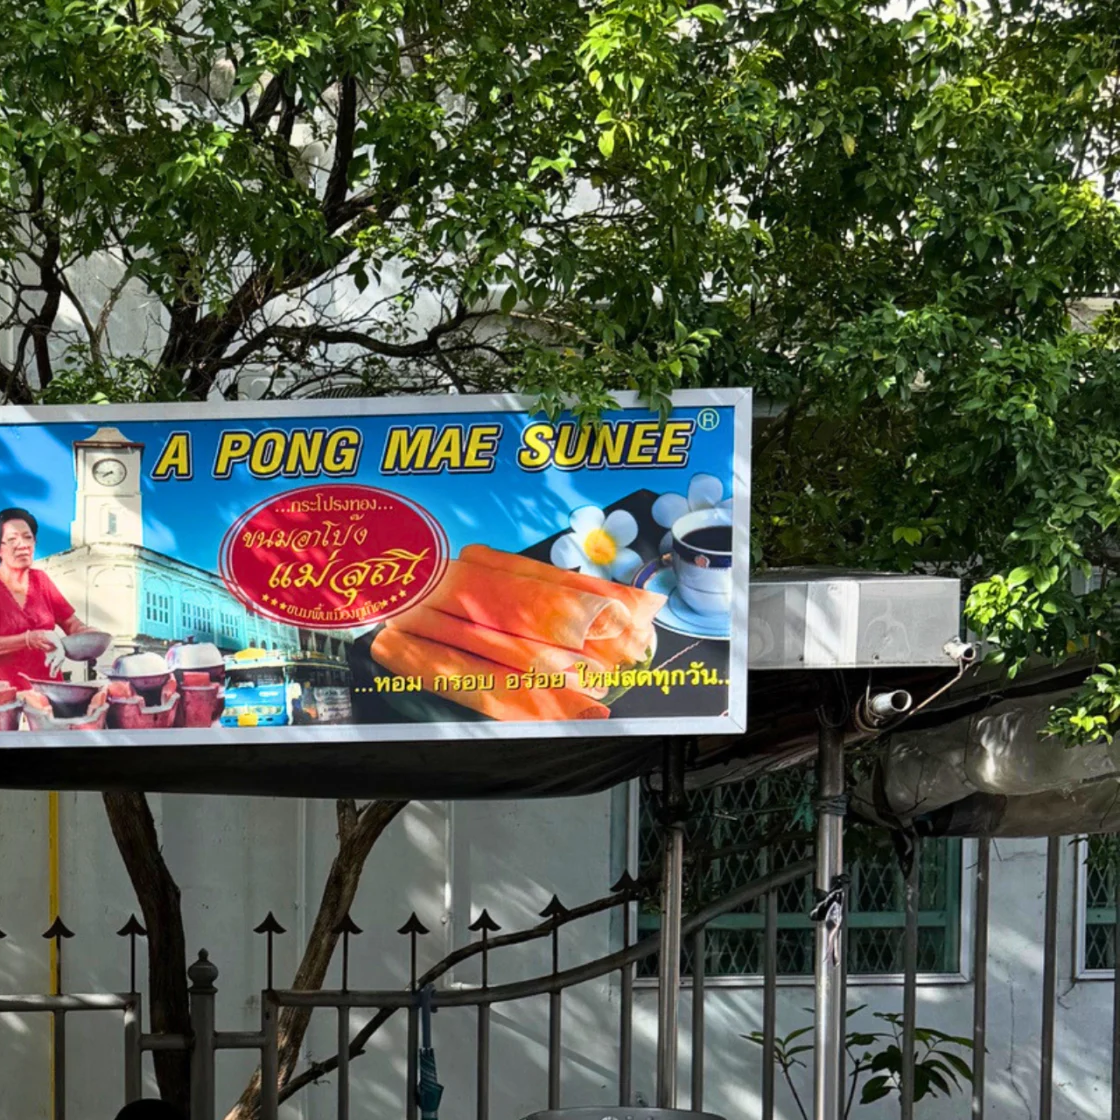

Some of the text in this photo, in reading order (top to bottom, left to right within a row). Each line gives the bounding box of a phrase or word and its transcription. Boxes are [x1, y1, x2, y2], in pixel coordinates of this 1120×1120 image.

[151, 430, 192, 479] A
[212, 425, 362, 478] PONG
[379, 422, 503, 476] MAE
[516, 419, 695, 472] SUNEE
[434, 671, 495, 691] กรอบ
[506, 667, 566, 690] อร่อย
